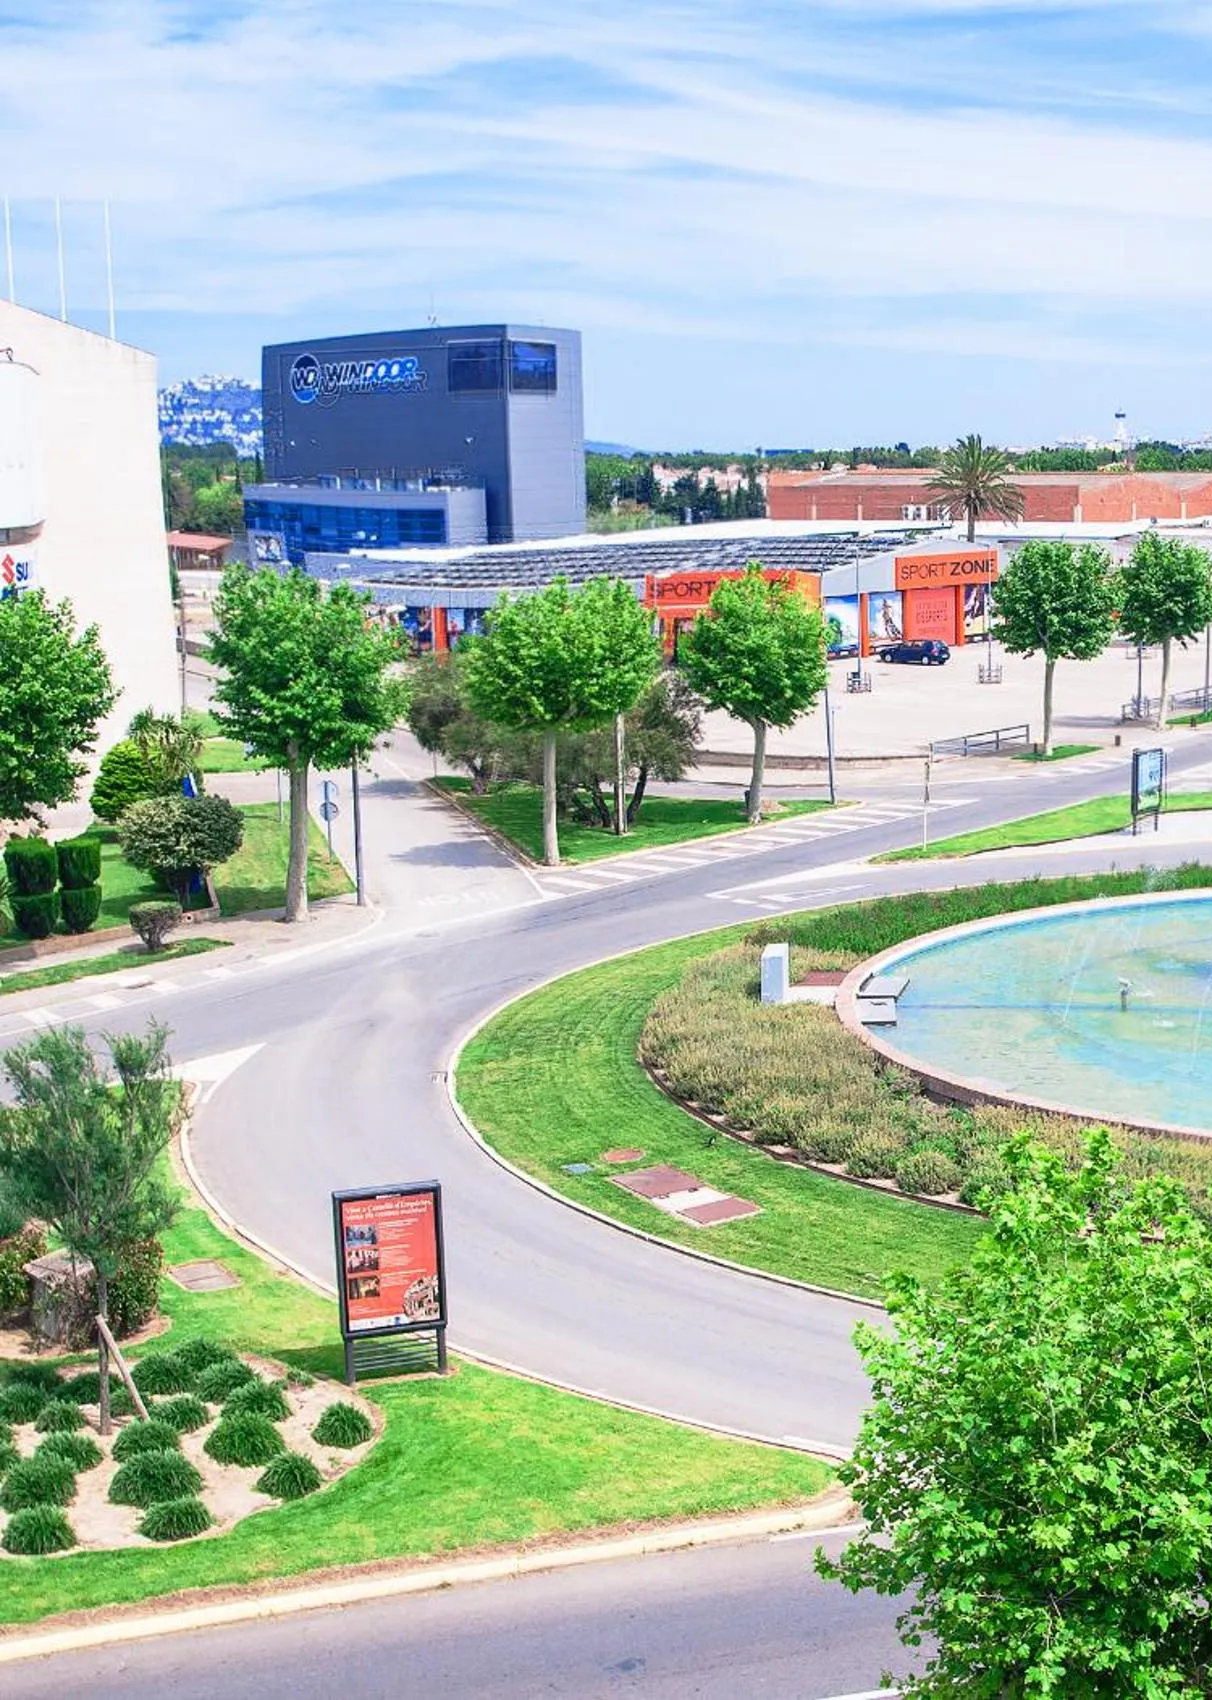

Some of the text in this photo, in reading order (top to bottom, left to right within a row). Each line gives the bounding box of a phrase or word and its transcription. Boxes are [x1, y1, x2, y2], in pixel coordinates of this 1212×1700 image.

[323, 357, 418, 385] WINDOOR
[901, 559, 994, 580] SPORT ZONE
